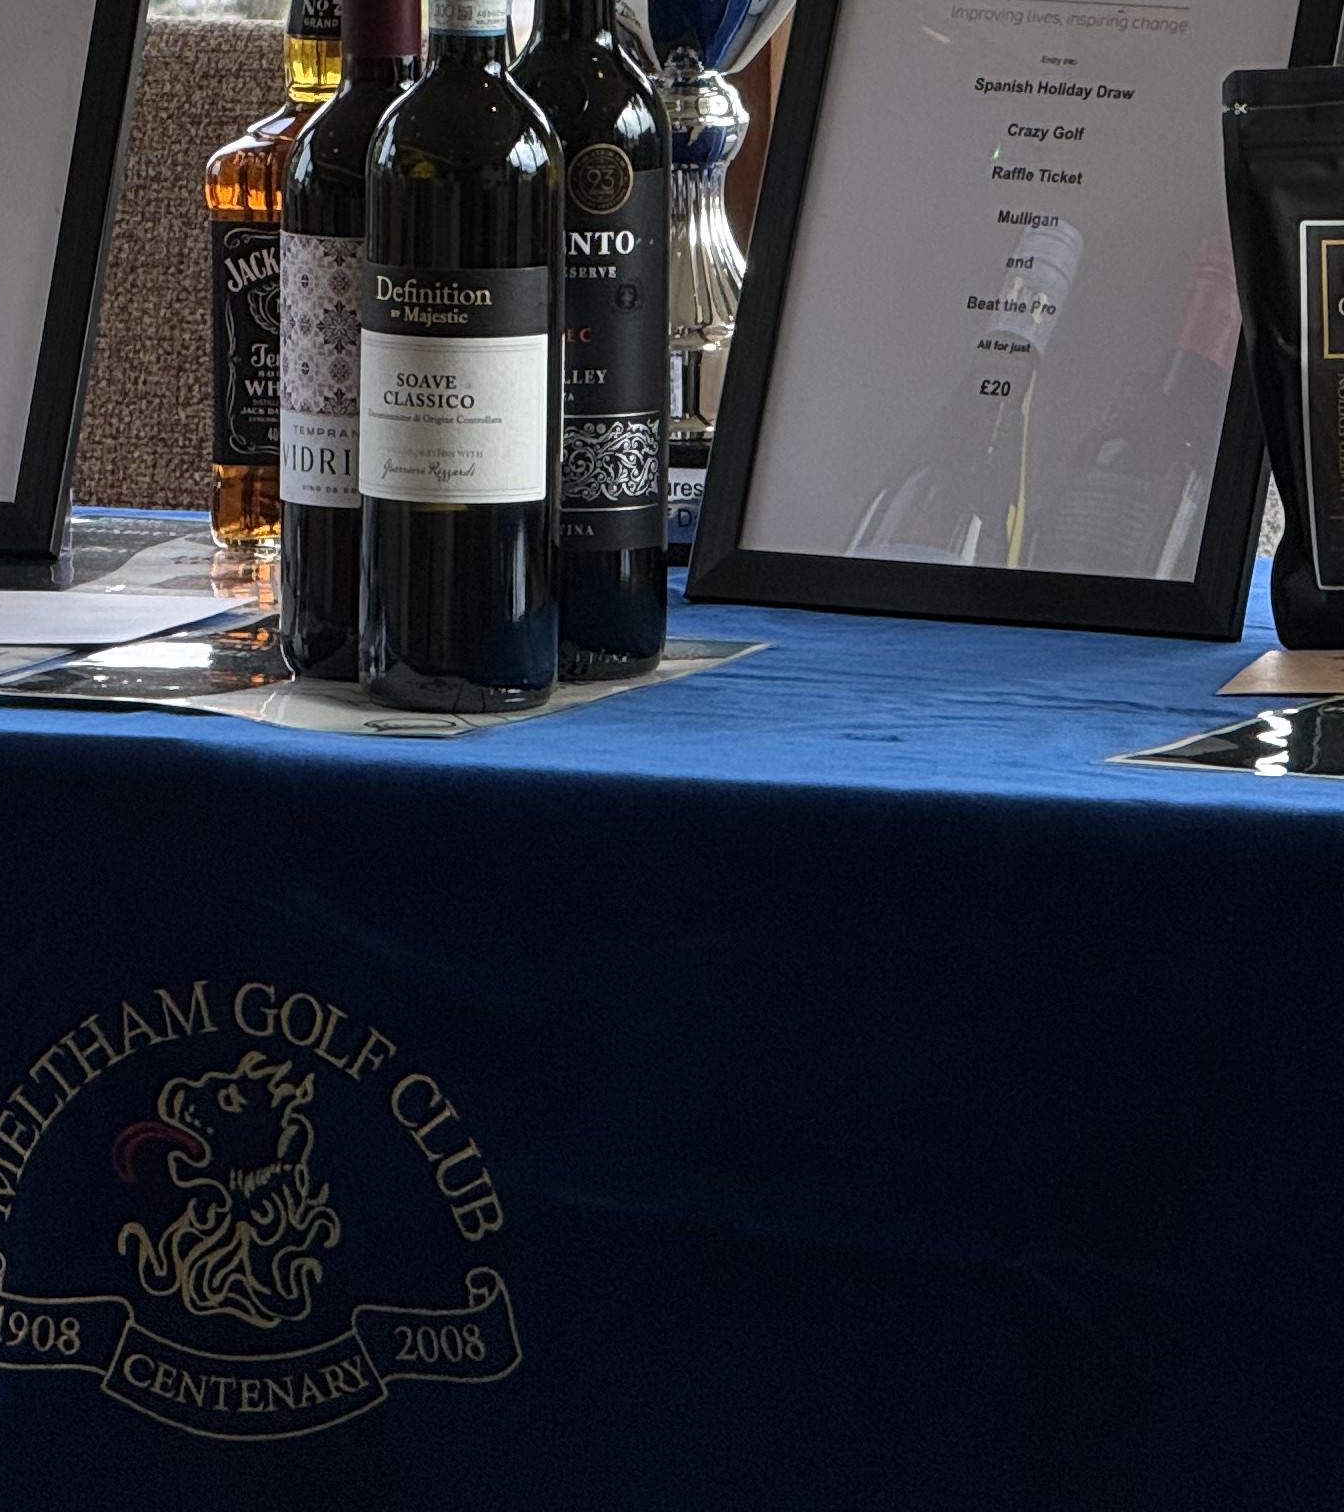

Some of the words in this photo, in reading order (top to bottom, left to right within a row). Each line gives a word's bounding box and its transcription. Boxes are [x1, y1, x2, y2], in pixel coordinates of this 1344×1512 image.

[1066, 9, 1129, 31] inspiring
[1131, 16, 1189, 34] change
[975, 77, 1033, 94] Spanish
[1037, 81, 1092, 100] Holiday
[1096, 85, 1135, 99] Draw
[1007, 123, 1048, 141] Crazy
[1053, 126, 1085, 140] Golf
[992, 166, 1033, 182] Raffle
[1039, 169, 1082, 184] Ticket
[997, 210, 1058, 229] Mulligan
[224, 247, 280, 292] JACK
[1006, 256, 1034, 269] and
[376, 275, 492, 305] Definition
[967, 296, 999, 312] Beat
[1004, 298, 1026, 313] the
[1030, 300, 1056, 315] Pro
[404, 306, 468, 327] Majestic
[977, 340, 991, 350] All
[994, 341, 1008, 351] for
[1010, 343, 1031, 353] just
[397, 373, 457, 389] SOAVE
[980, 380, 1011, 396] £20
[384, 390, 475, 409] CLASSICO
[234, 982, 396, 1080] GOLF
[390, 1073, 504, 1242] CLUB
[395, 1325, 486, 1363] 2008
[123, 1353, 369, 1413] CENTENARY
